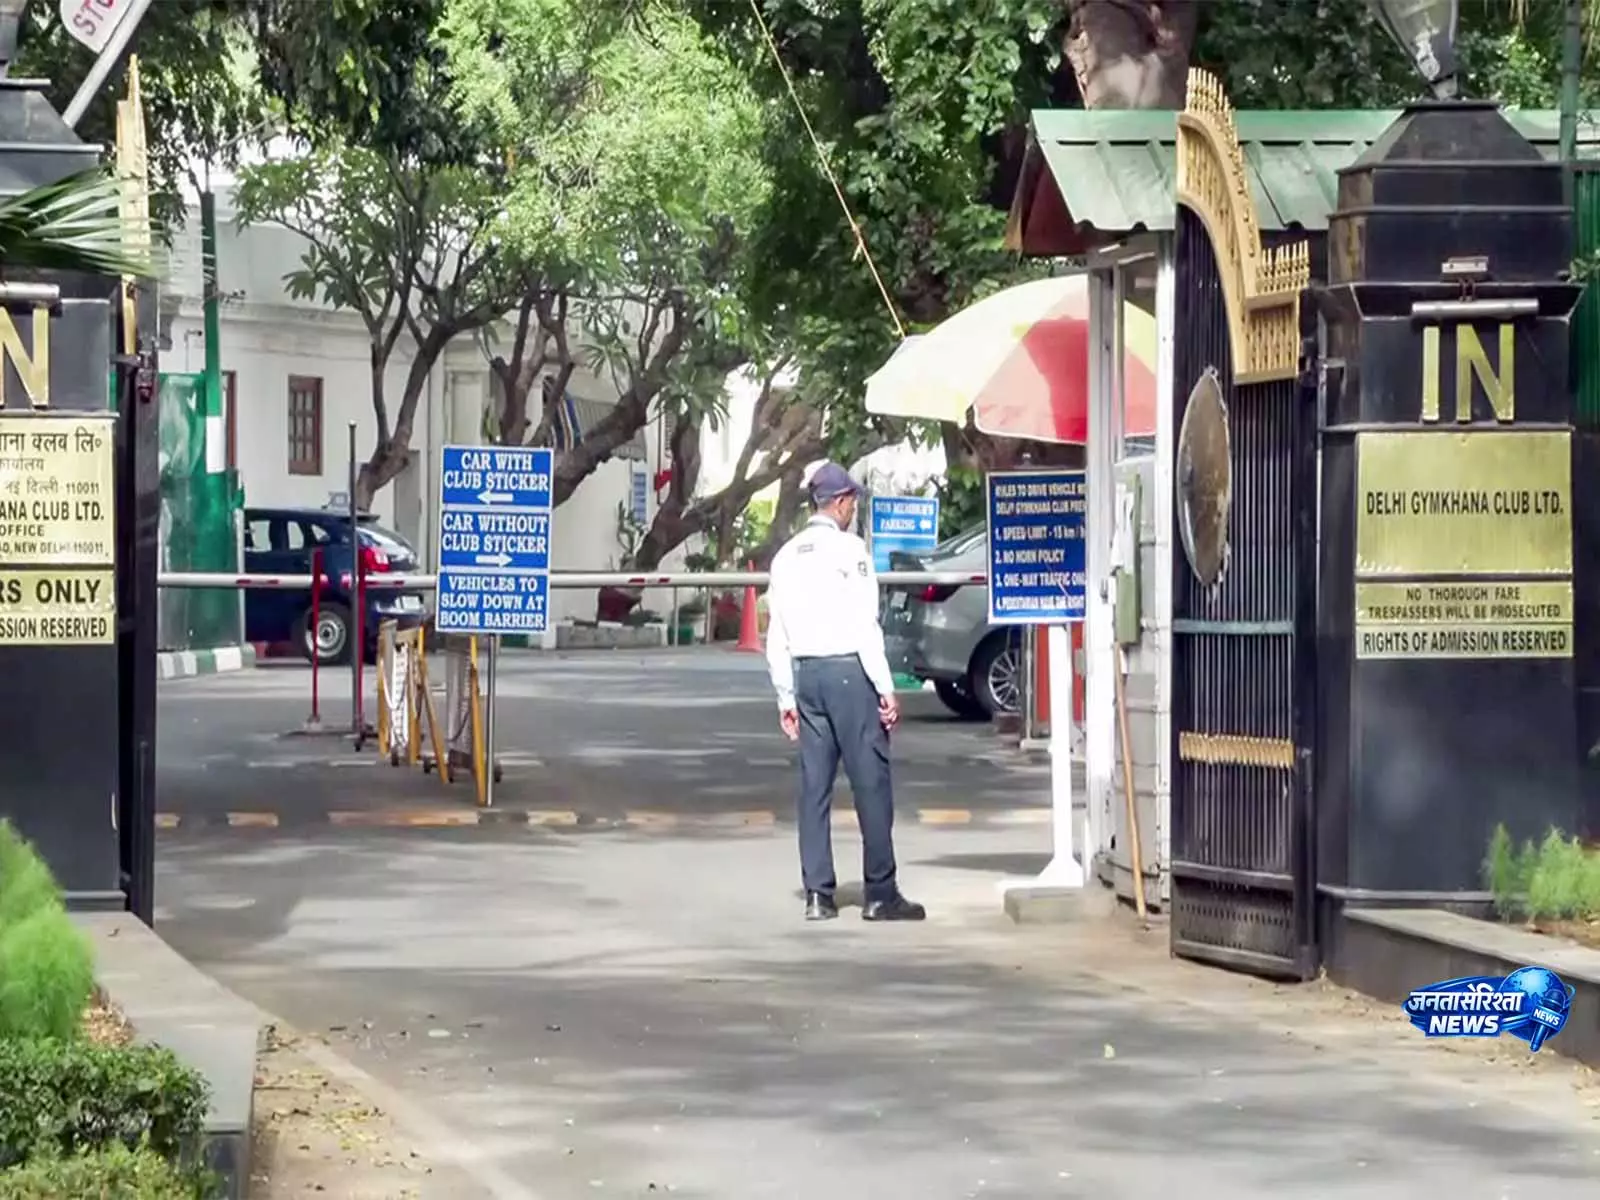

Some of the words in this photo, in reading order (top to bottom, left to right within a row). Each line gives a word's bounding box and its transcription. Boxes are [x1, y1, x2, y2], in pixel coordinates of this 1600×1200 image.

[1422, 324, 1514, 420] IN
[461, 451, 491, 470] CAR
[495, 453, 533, 470] WITH
[444, 471, 482, 488] CLUB
[486, 472, 549, 491] STICKER
[33, 501, 69, 520] CLUB
[76, 501, 104, 520] LTD.
[1367, 491, 1406, 514] DELHI
[1411, 491, 1490, 514] GYMKHANA
[1494, 491, 1530, 514] CLUB
[1535, 491, 1564, 514] LTD.
[442, 513, 473, 531] CAR
[478, 514, 547, 533] WITHOUT
[1003, 526, 1026, 541] SPEED
[1027, 526, 1047, 540] LIMIT
[15, 542, 37, 554] NEW
[442, 534, 480, 551] CLUB
[484, 535, 546, 553] STICKER
[1003, 550, 1014, 564] NO
[1015, 549, 1037, 563] HORN
[1038, 549, 1064, 563] POLICY
[448, 576, 516, 591] VEHICLES
[519, 578, 538, 592] TO
[1040, 571, 1070, 586] TRAFFIC
[36, 579, 101, 603] ONLY
[1406, 588, 1422, 601] NO
[1430, 588, 1488, 601] THOROUGH
[1495, 587, 1520, 600] FARE
[441, 593, 479, 608] SLOW
[482, 595, 523, 609] DOWN
[526, 596, 544, 610] AT
[440, 611, 480, 626] BOOM
[484, 612, 544, 628] BARRIER
[1368, 606, 1442, 619] TRESPASSERS
[1445, 605, 1470, 619] WILL
[1474, 605, 1487, 618] BE
[1491, 604, 1561, 618] PROSECUTED
[41, 618, 107, 638] RESERVED
[1364, 632, 1408, 652] RIGHTS
[1412, 632, 1428, 651] OF
[1431, 631, 1499, 651] ADMISSION
[1502, 631, 1566, 650] RESERVED
